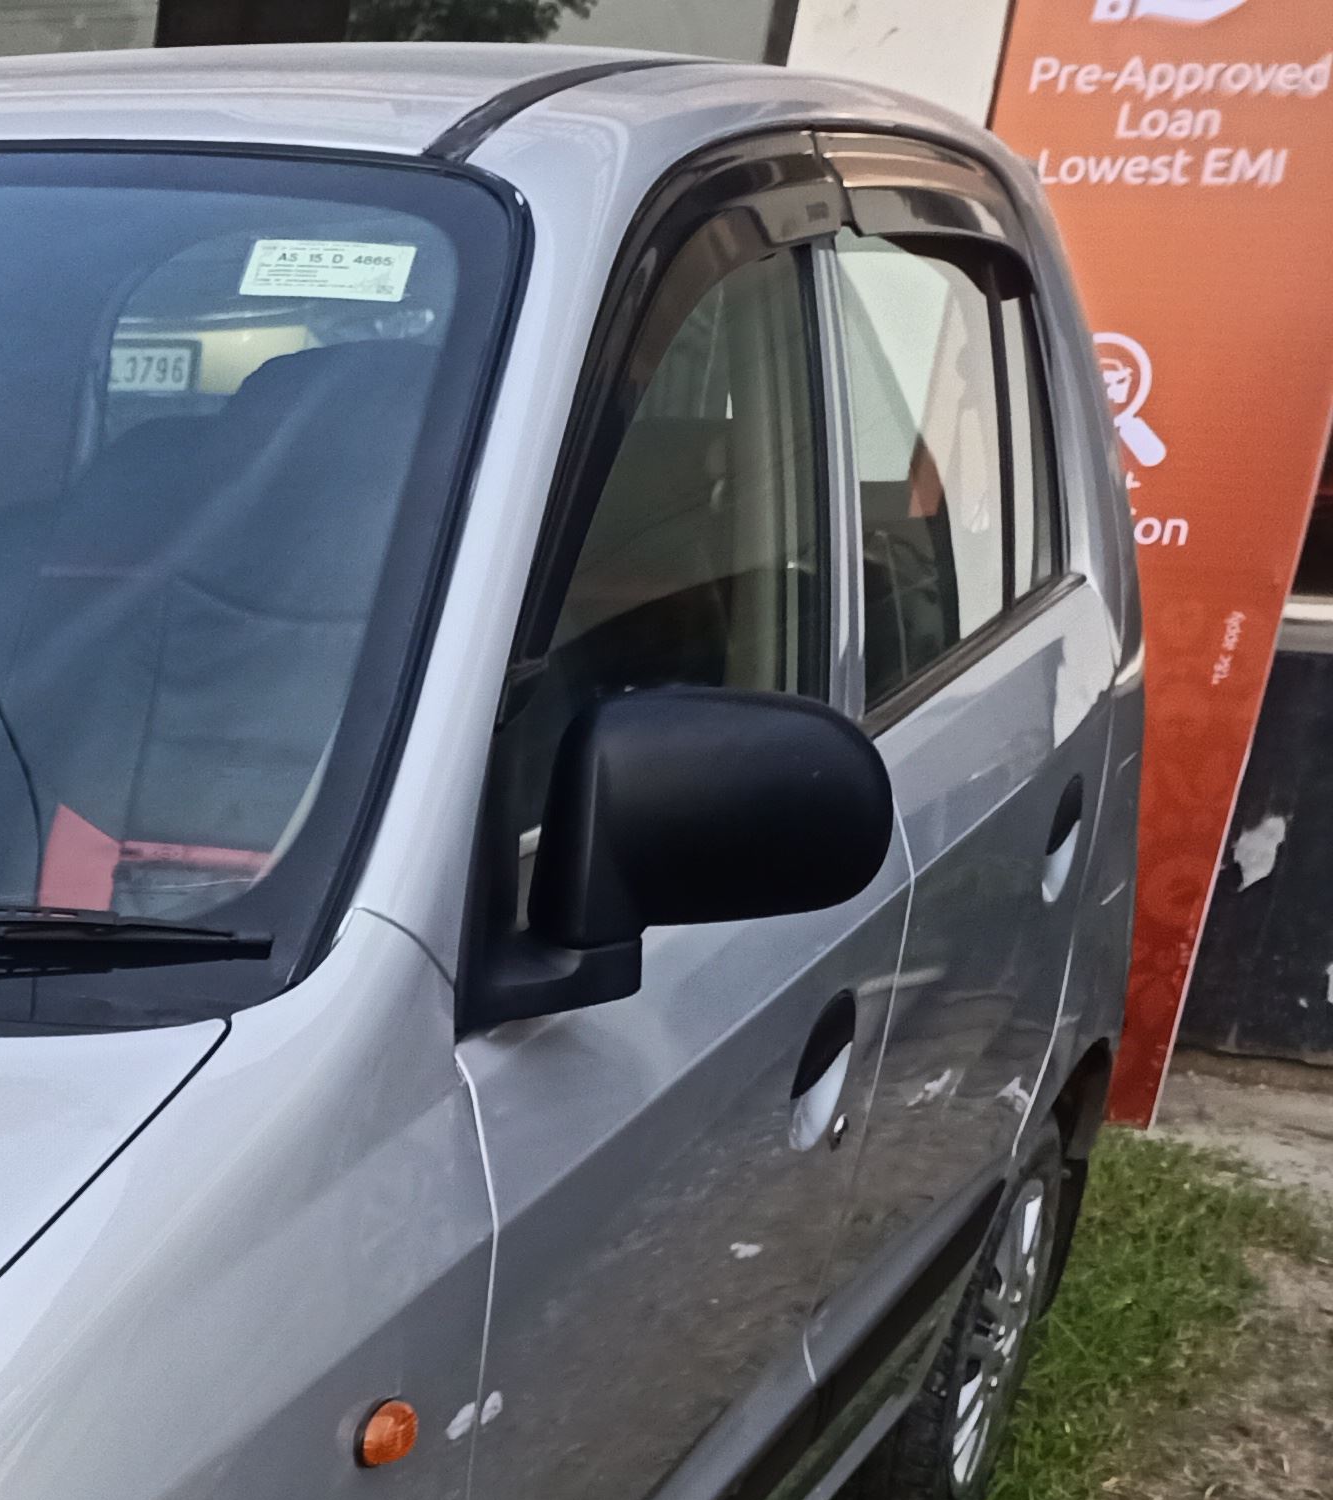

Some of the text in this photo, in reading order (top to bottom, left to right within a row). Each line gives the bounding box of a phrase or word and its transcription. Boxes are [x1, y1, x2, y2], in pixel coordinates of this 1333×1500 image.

[1028, 54, 1333, 101] Pre-Approved
[1114, 101, 1221, 139] Loan
[1037, 147, 1289, 187] Lowest EMI
[277, 252, 298, 263] AS
[308, 253, 324, 264] 15
[333, 254, 344, 264] D
[352, 255, 393, 267] 4865
